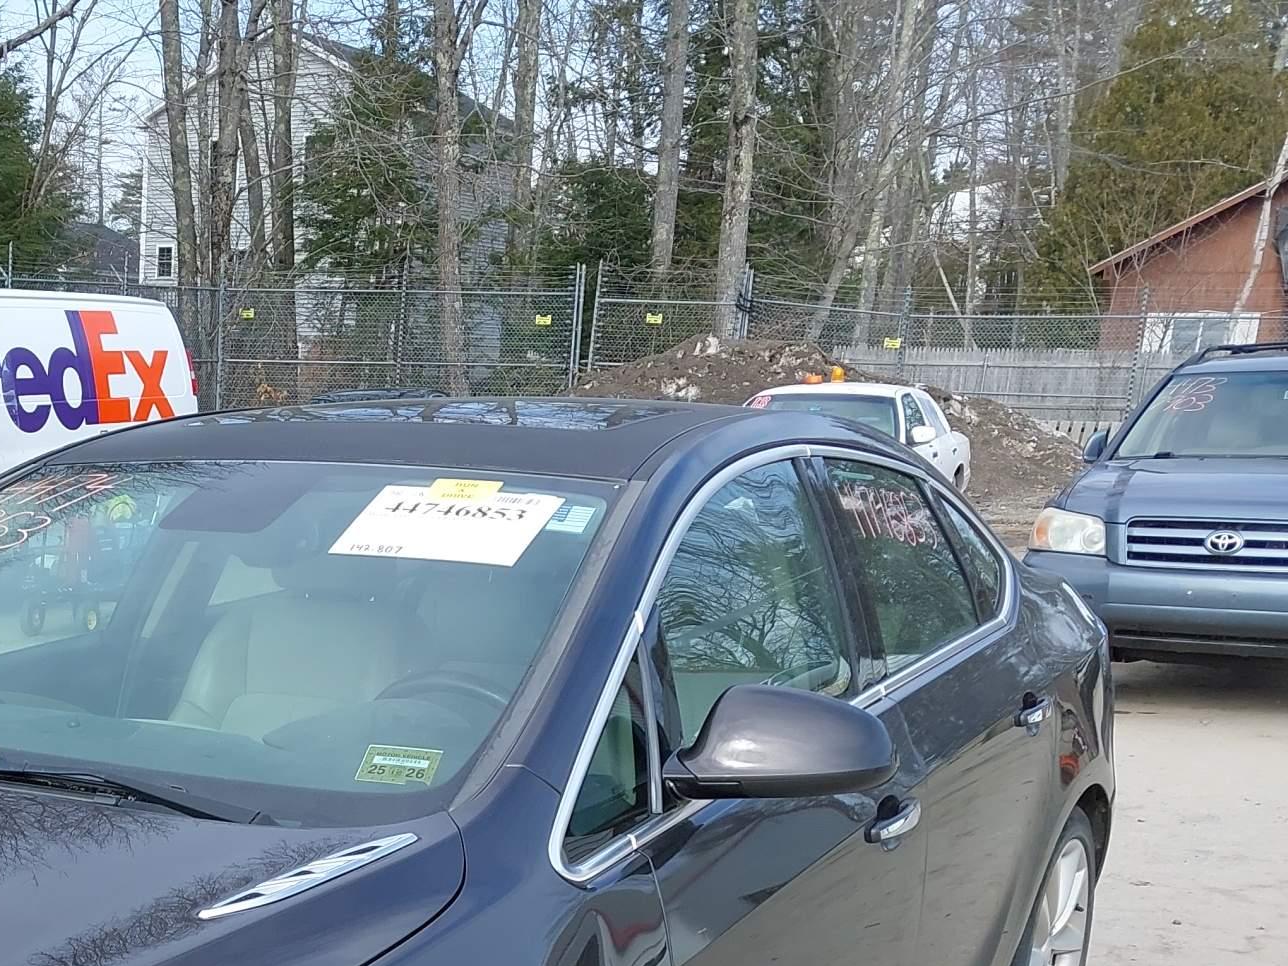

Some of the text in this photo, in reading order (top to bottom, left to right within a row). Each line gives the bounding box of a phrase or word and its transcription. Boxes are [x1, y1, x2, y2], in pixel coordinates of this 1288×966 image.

[384, 499, 528, 521] 44746853
[367, 764, 387, 775] 25
[405, 768, 426, 779] 26
